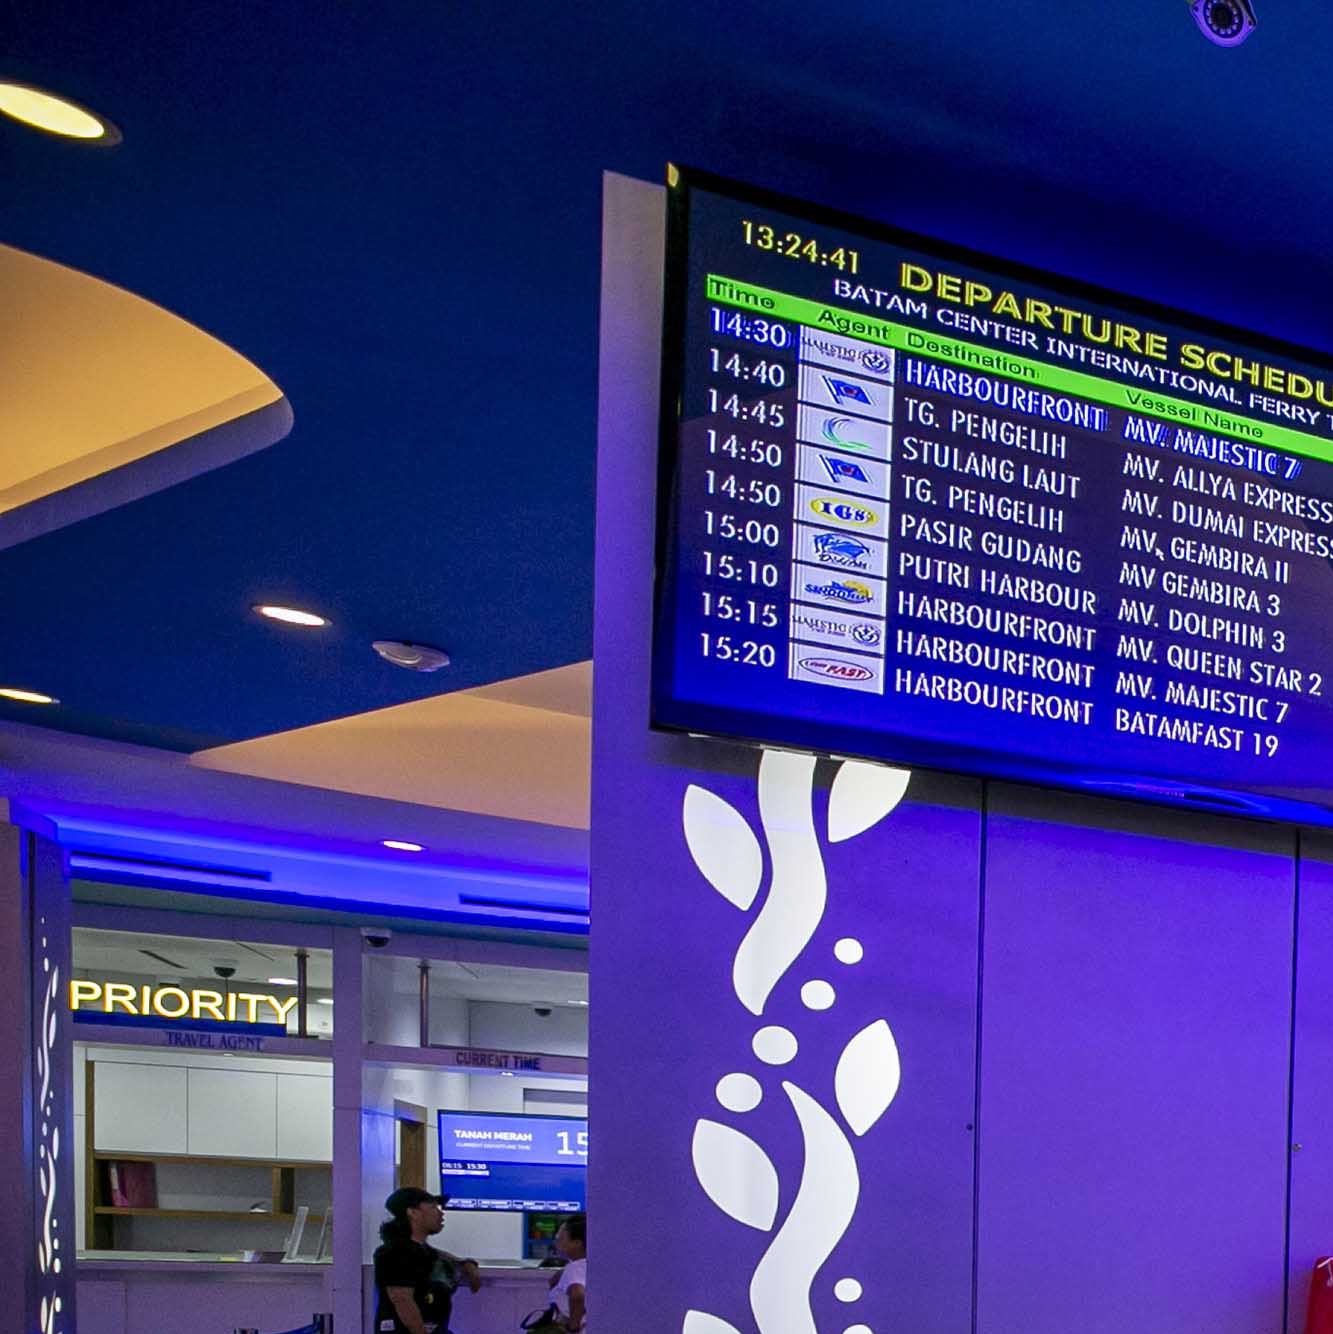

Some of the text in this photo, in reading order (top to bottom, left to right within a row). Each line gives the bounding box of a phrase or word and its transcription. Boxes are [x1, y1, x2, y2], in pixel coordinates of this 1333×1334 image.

[742, 220, 858, 274] 13:24:41
[900, 262, 1168, 361] DEPARTURE
[709, 278, 775, 310] Time
[818, 308, 889, 342] Agent
[907, 332, 1037, 379] Destination
[1126, 389, 1198, 423] Vessel
[1204, 407, 1263, 440] Name
[711, 307, 787, 348] 14:30
[905, 359, 1103, 432] HARBOURFRONT
[1174, 429, 1277, 476] MAJESTIC
[1285, 457, 1298, 480] 7
[834, 279, 927, 320] BATAM
[937, 308, 1038, 350] CENTER
[1047, 338, 1242, 405] INTERNATIONAL
[1248, 394, 1320, 425] FERRY
[707, 430, 782, 468] 14:50
[902, 475, 937, 506] TG.
[949, 488, 1064, 534] PENGELIH
[1171, 539, 1268, 580] GEMBIRA
[1275, 558, 1290, 585] II
[709, 349, 785, 388] 14:40
[904, 397, 940, 429] TG.
[951, 410, 1067, 460] PENGELIH
[1123, 452, 1164, 484] MV.
[1173, 465, 1236, 502] ALLYA
[1243, 485, 1333, 525] EXPRESS
[709, 390, 785, 429] 14:45
[902, 437, 1014, 485] STULANG
[1023, 466, 1081, 500] LAUT
[1122, 489, 1163, 520] MV.
[1173, 501, 1244, 539] DUMAI
[704, 512, 780, 548] 15:00
[900, 554, 969, 590] PUTRI
[981, 570, 1097, 616] HARBOUR
[1118, 598, 1160, 627] MV.
[1169, 609, 1264, 651] DOLPHIN
[1272, 631, 1286, 653] 3
[706, 471, 781, 508] 14:50
[901, 514, 972, 550] PASIR
[981, 531, 1082, 575] GUDANG
[1120, 562, 1156, 589] MV
[1163, 571, 1260, 613] GEMBIRA
[1267, 594, 1281, 616] 3
[702, 592, 777, 628] 15:15
[897, 630, 1095, 689] HARBOURFRONT
[1116, 672, 1156, 701] MV.
[1166, 682, 1268, 721] MAJESTIC
[1275, 701, 1289, 724] 7
[703, 552, 778, 588] 15:10
[898, 592, 1096, 653] HARBOURFRONT
[1117, 635, 1157, 664] MV.
[1167, 645, 1242, 680] QUEEN
[1250, 661, 1301, 693] STAR
[1308, 672, 1323, 696] 2
[701, 633, 776, 668] 15:20
[895, 669, 1093, 726] HARBOURFRONT
[1115, 708, 1243, 753] BATAMFAST
[1253, 732, 1279, 759] 19
[70, 980, 299, 1025] PRIORITY
[165, 1031, 264, 1053] TRAVEL AGENT
[456, 1052, 541, 1071] CURRENT TIME
[453, 1129, 533, 1142] TANAH MERAH
